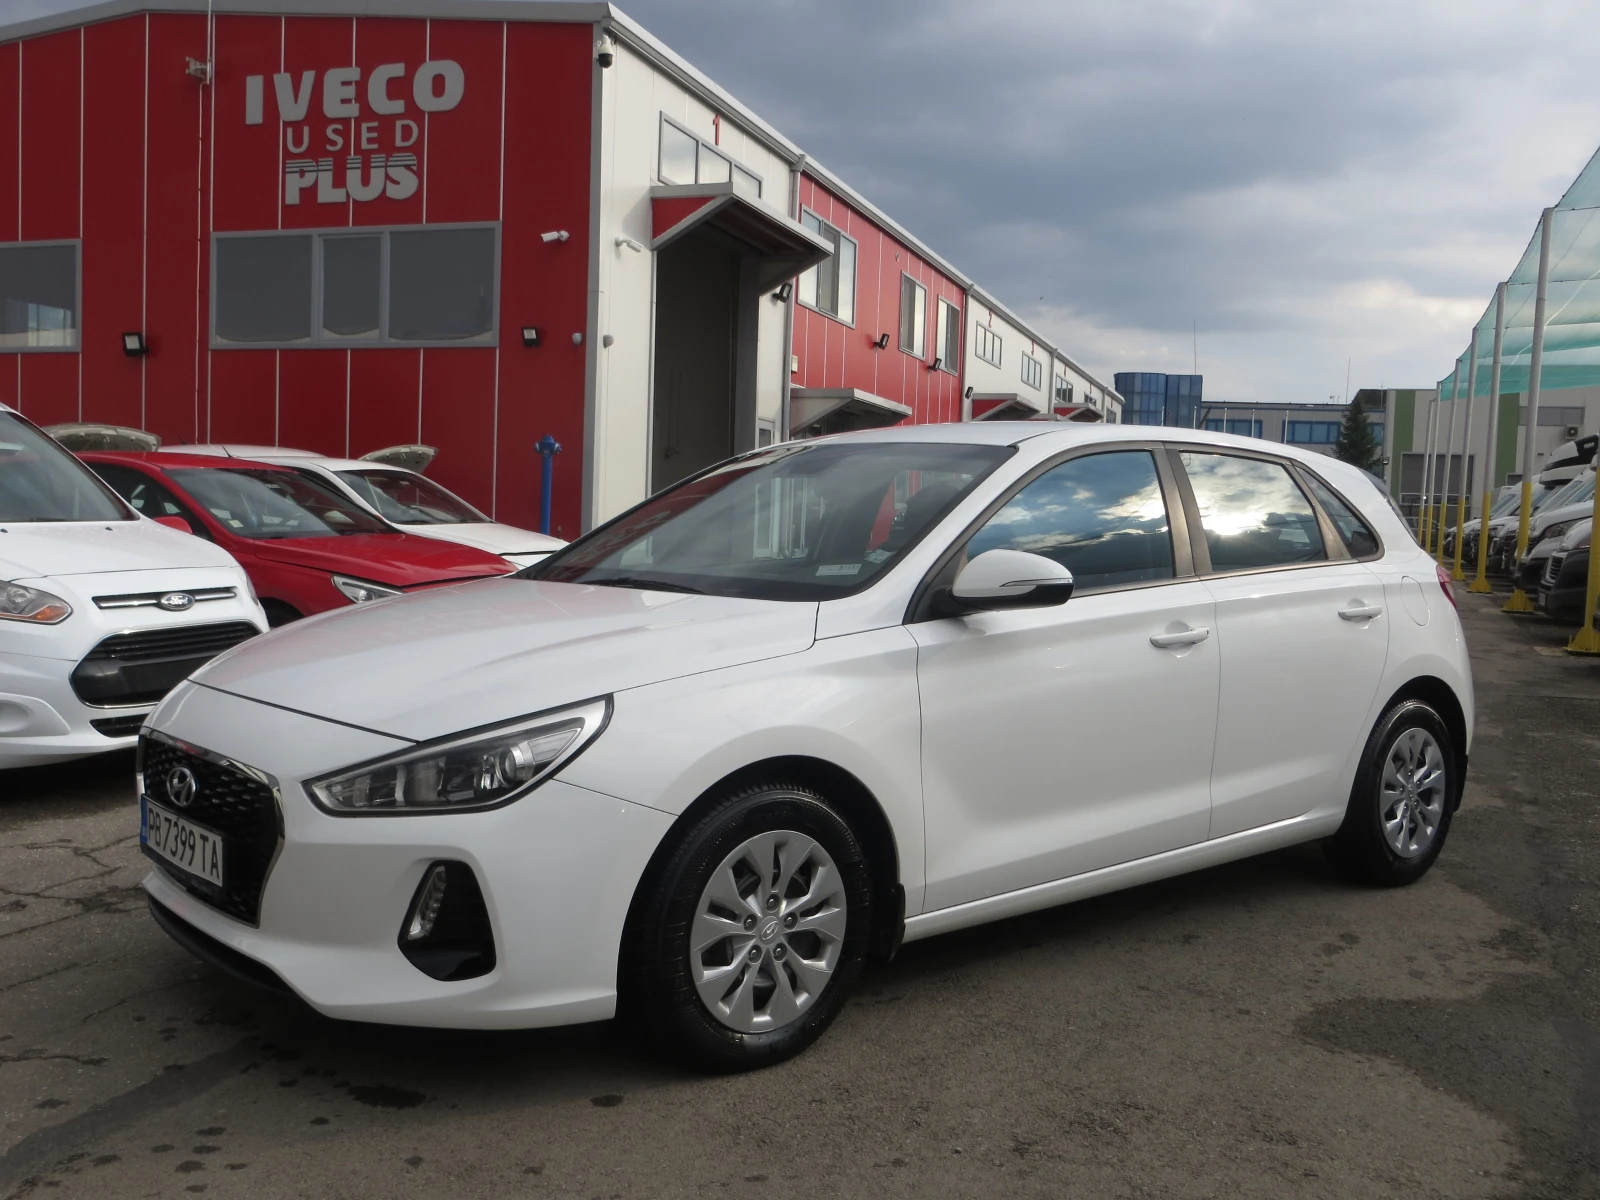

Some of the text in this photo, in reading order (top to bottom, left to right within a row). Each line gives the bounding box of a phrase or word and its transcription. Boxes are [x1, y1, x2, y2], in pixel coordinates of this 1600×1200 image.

[245, 59, 465, 125] IVECO
[286, 119, 419, 154] USED
[285, 152, 419, 205] PLUS
